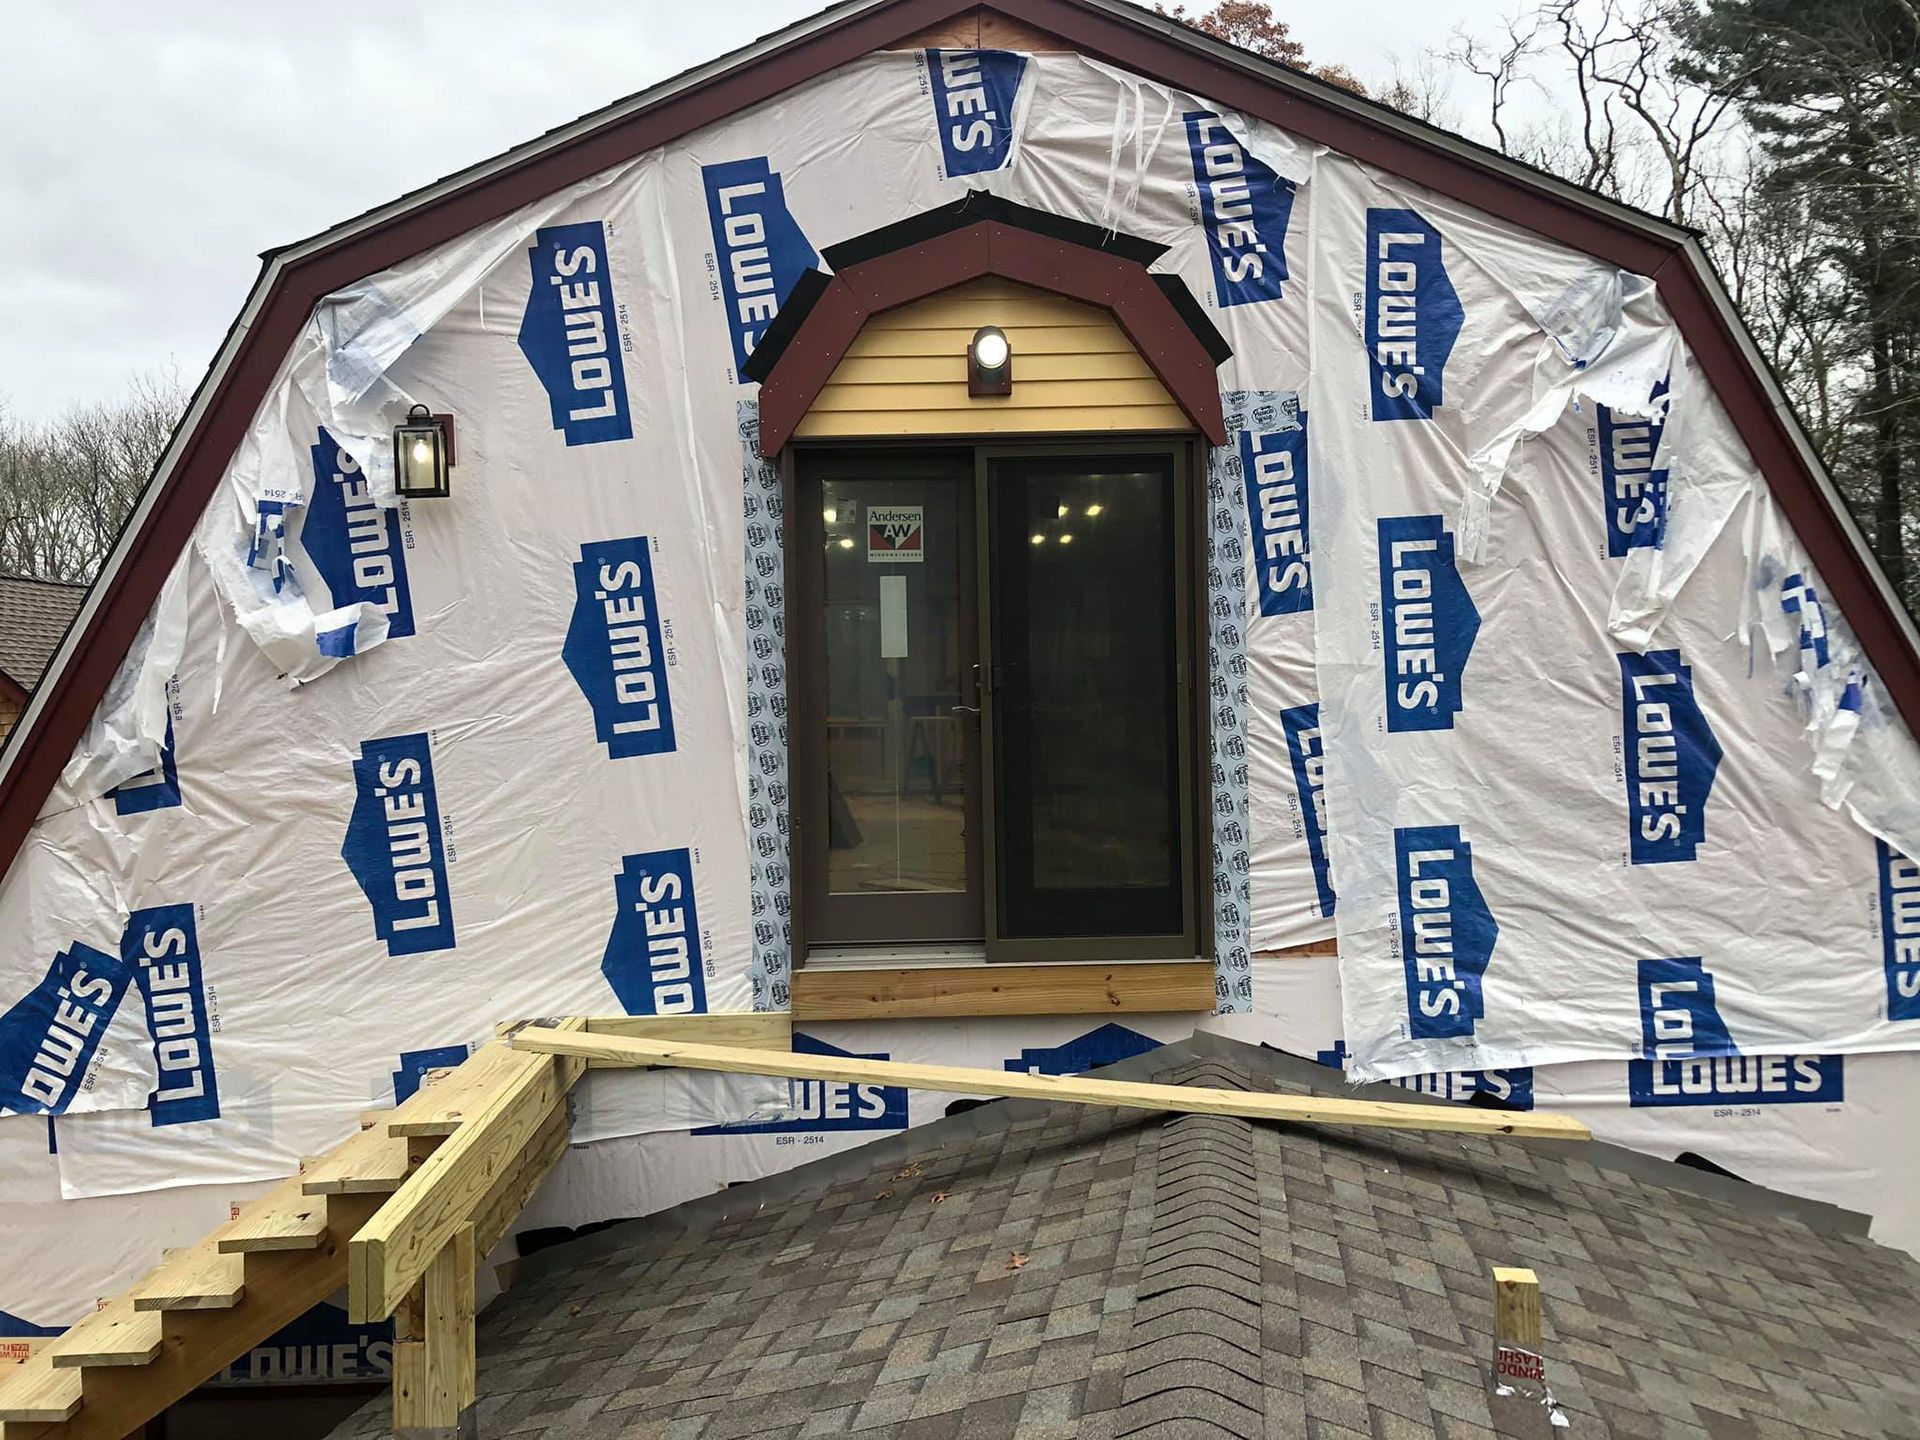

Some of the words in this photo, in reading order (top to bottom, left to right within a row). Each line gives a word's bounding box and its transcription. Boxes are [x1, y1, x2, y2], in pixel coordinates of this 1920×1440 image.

[939, 50, 997, 152] WE'S
[550, 245, 617, 421] LOWE'S
[718, 182, 779, 357] LOWE
[1378, 233, 1425, 400] LOWE'S
[870, 510, 921, 521] Andersen
[1610, 408, 1655, 534] WE'S
[594, 560, 660, 735] LOWE'S
[1391, 540, 1444, 710] LOWE'S
[1632, 673, 1687, 842] LOWE'S
[374, 757, 440, 931] LOWE'S
[139, 927, 204, 1102] LOWE'S
[635, 872, 695, 1014] OWE'S
[1408, 849, 1465, 1018] LOWE'S
[21, 969, 113, 1107] OWE'S
[1652, 1055, 1823, 1095] LOWES
